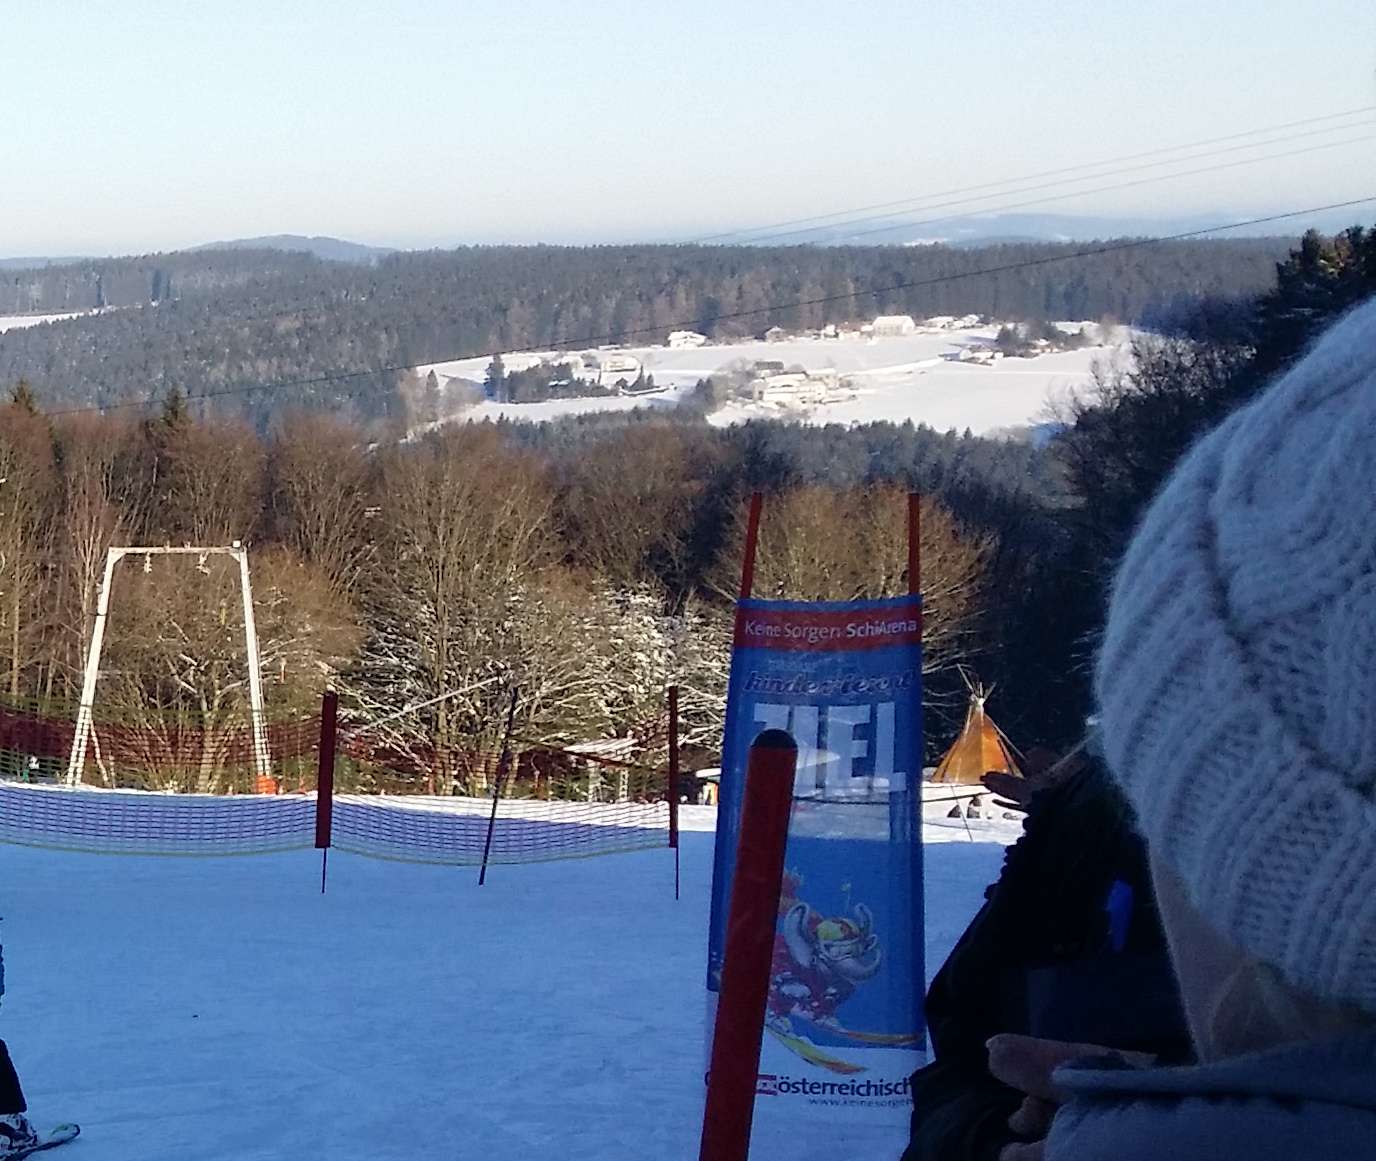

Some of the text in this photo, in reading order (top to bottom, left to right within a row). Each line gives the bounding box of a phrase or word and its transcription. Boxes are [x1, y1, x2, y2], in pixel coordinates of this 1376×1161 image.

[745, 619, 917, 643] Keine Sorgen SchiArena
[778, 1076, 912, 1097] österreichisch
